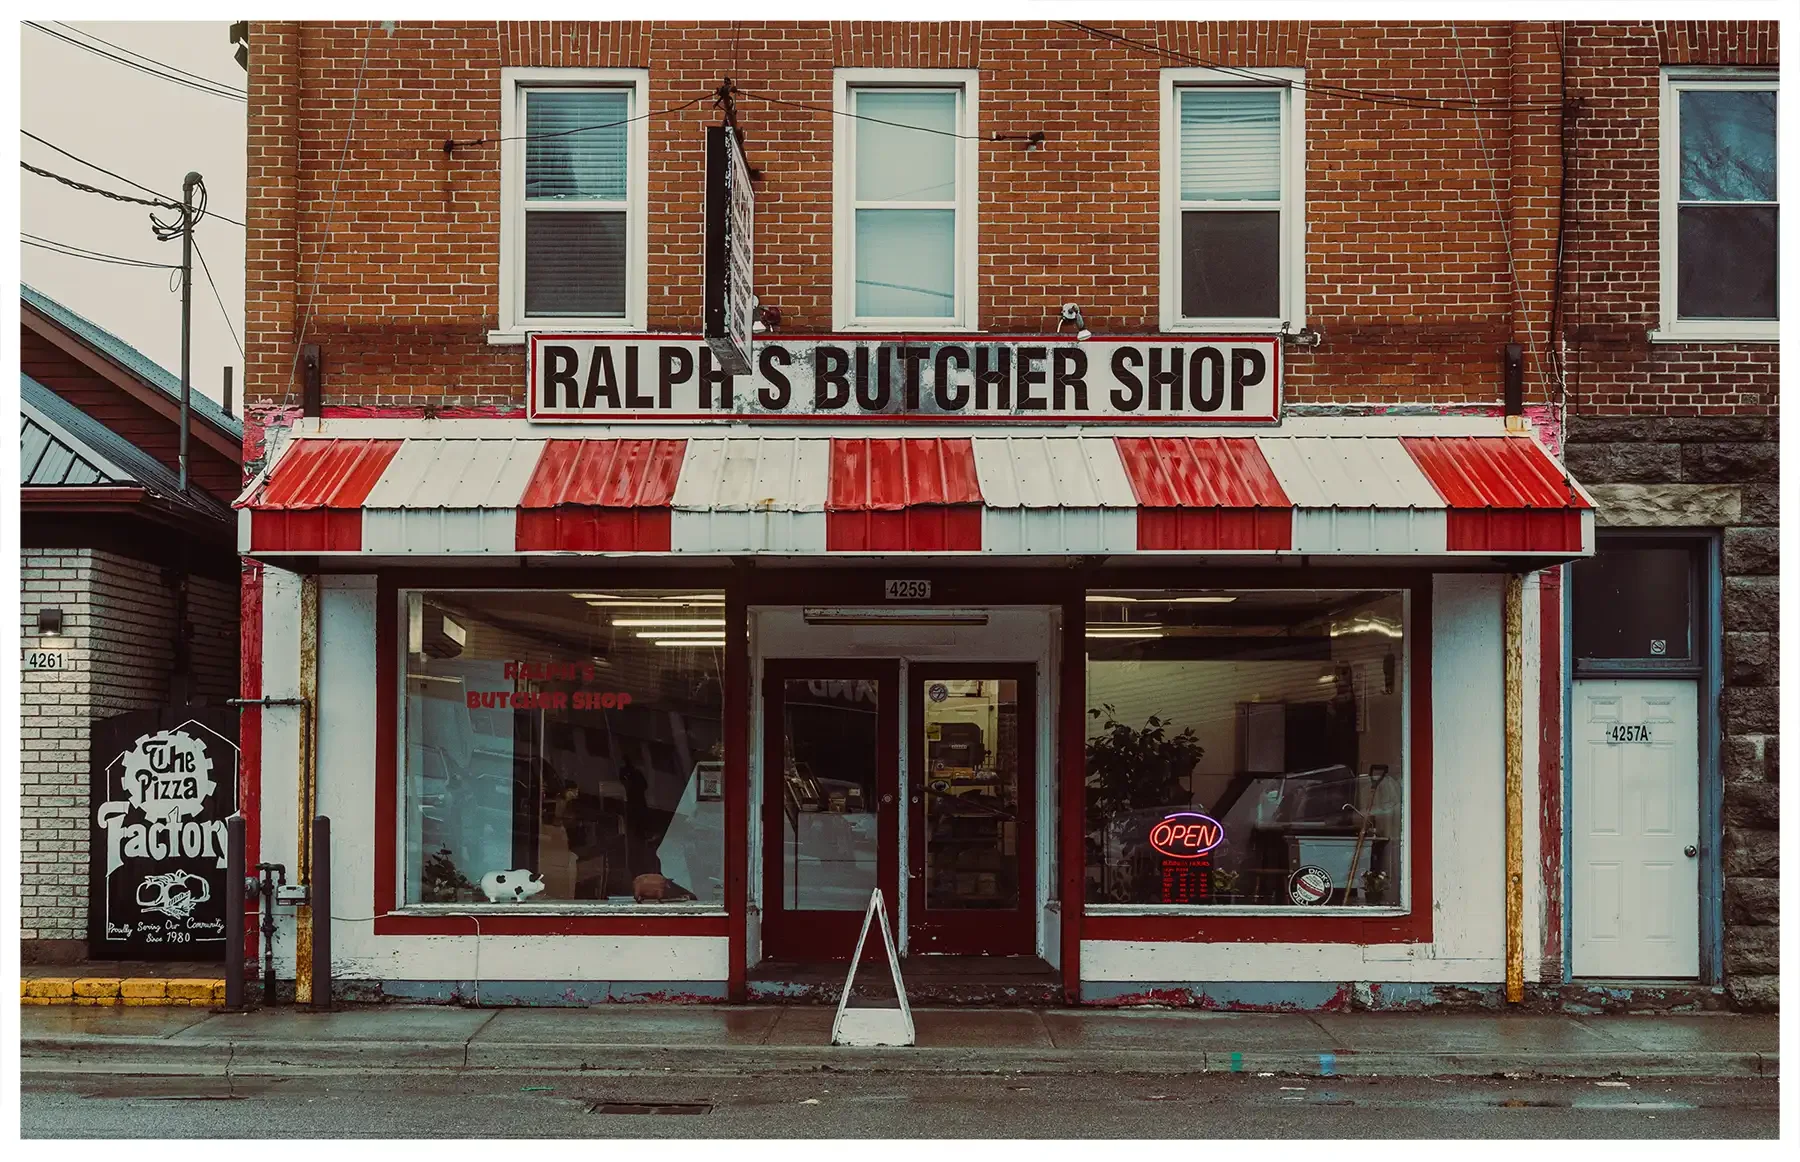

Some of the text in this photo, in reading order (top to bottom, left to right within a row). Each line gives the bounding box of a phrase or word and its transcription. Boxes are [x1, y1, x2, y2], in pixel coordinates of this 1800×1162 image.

[543, 345, 1266, 412] RALPHS BUTCHER SHOP
[889, 580, 927, 598] 4259
[29, 652, 63, 669] 4261
[504, 660, 596, 681] RALPH'S
[466, 690, 633, 710] BUTCHER SHOP
[1611, 725, 1650, 741] 4257A
[142, 740, 196, 773] The
[135, 769, 198, 803] Pizza
[1154, 824, 1217, 847] OPEN
[1308, 868, 1330, 888] DICK'S
[1292, 891, 1309, 906] DELI
[108, 917, 225, 937] Proudly Serving Our Community
[146, 931, 191, 944] Since 1980
